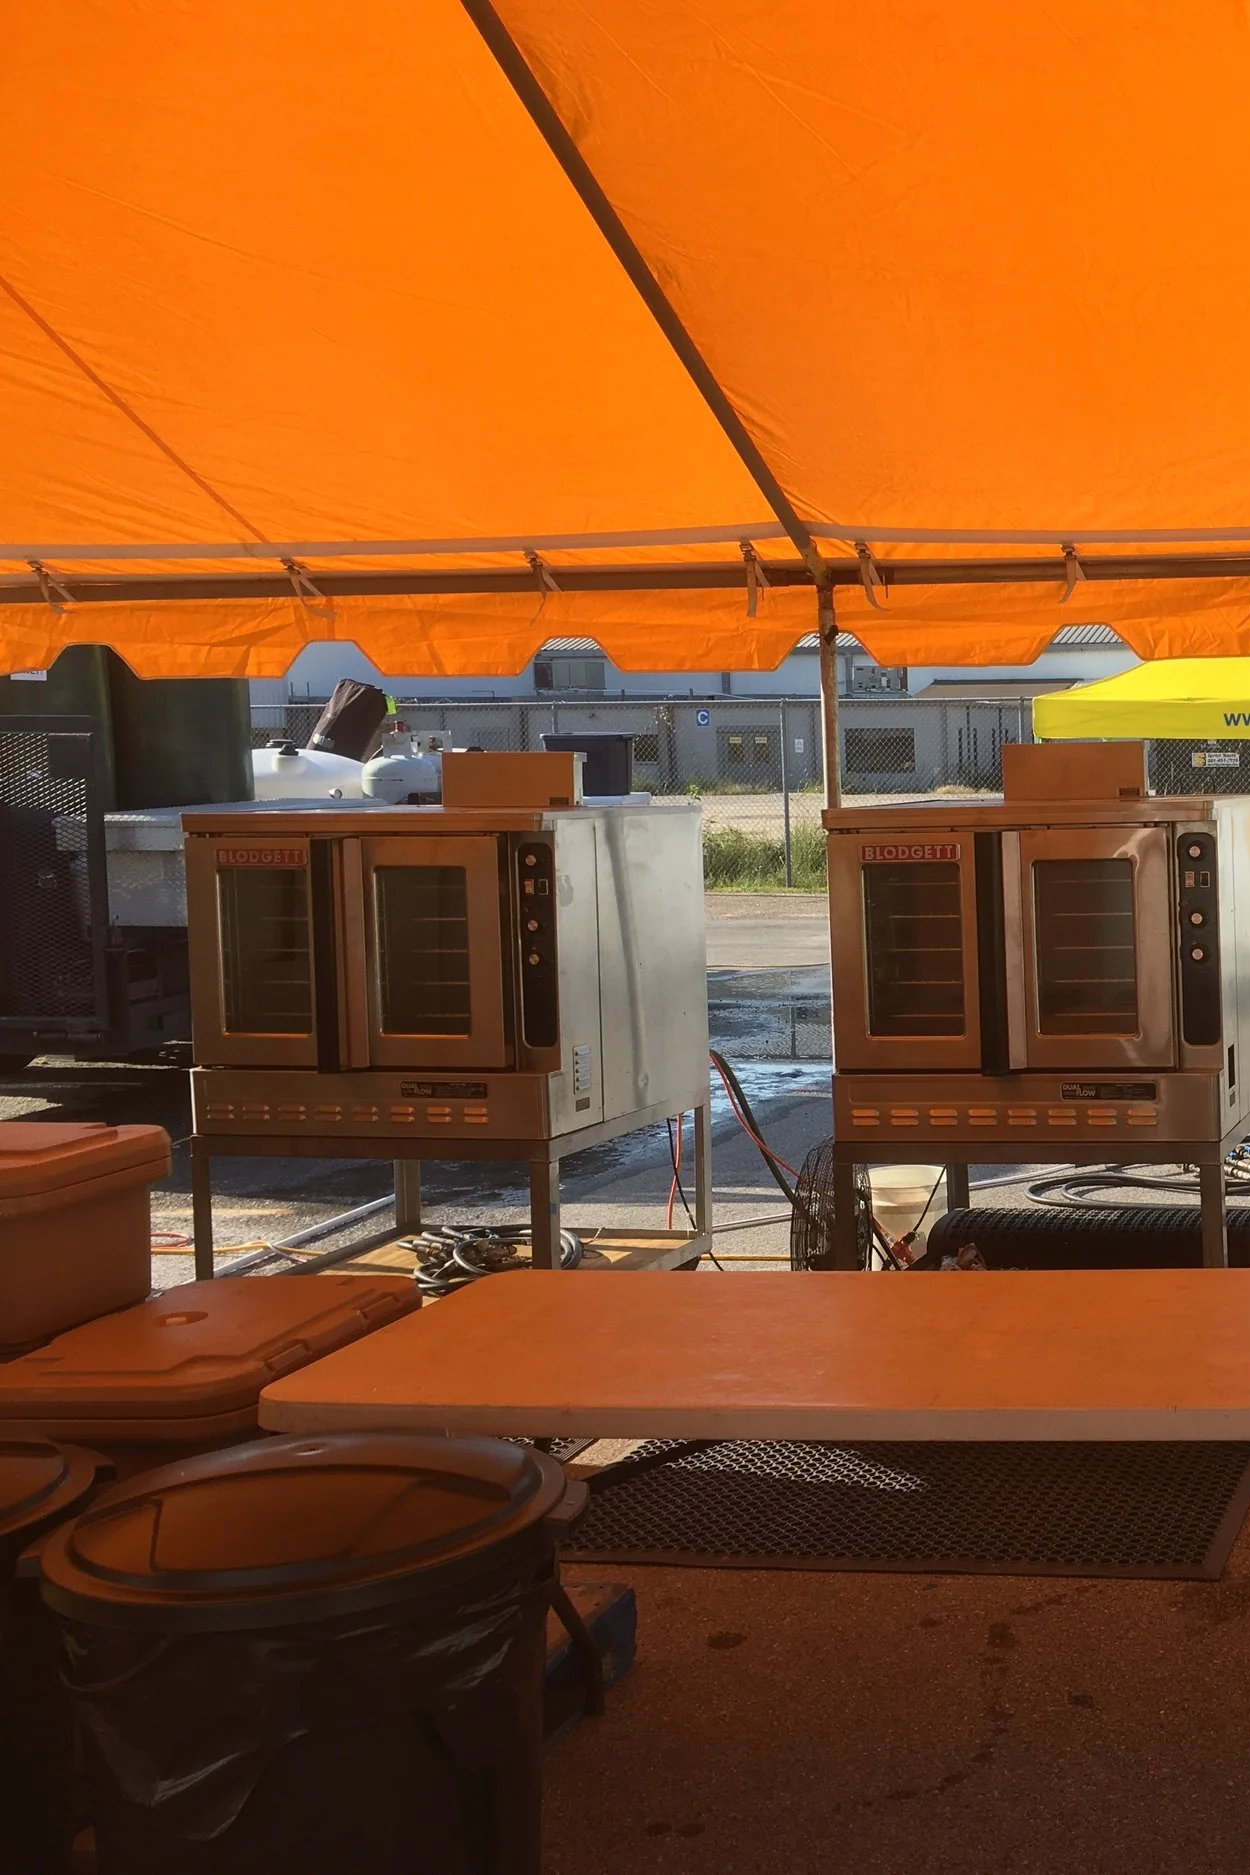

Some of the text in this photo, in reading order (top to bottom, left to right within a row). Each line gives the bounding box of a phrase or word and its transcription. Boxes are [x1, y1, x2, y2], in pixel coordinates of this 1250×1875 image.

[697, 711, 709, 725] C
[219, 850, 300, 863] BLODGETT
[865, 845, 953, 860] BLODGETT
